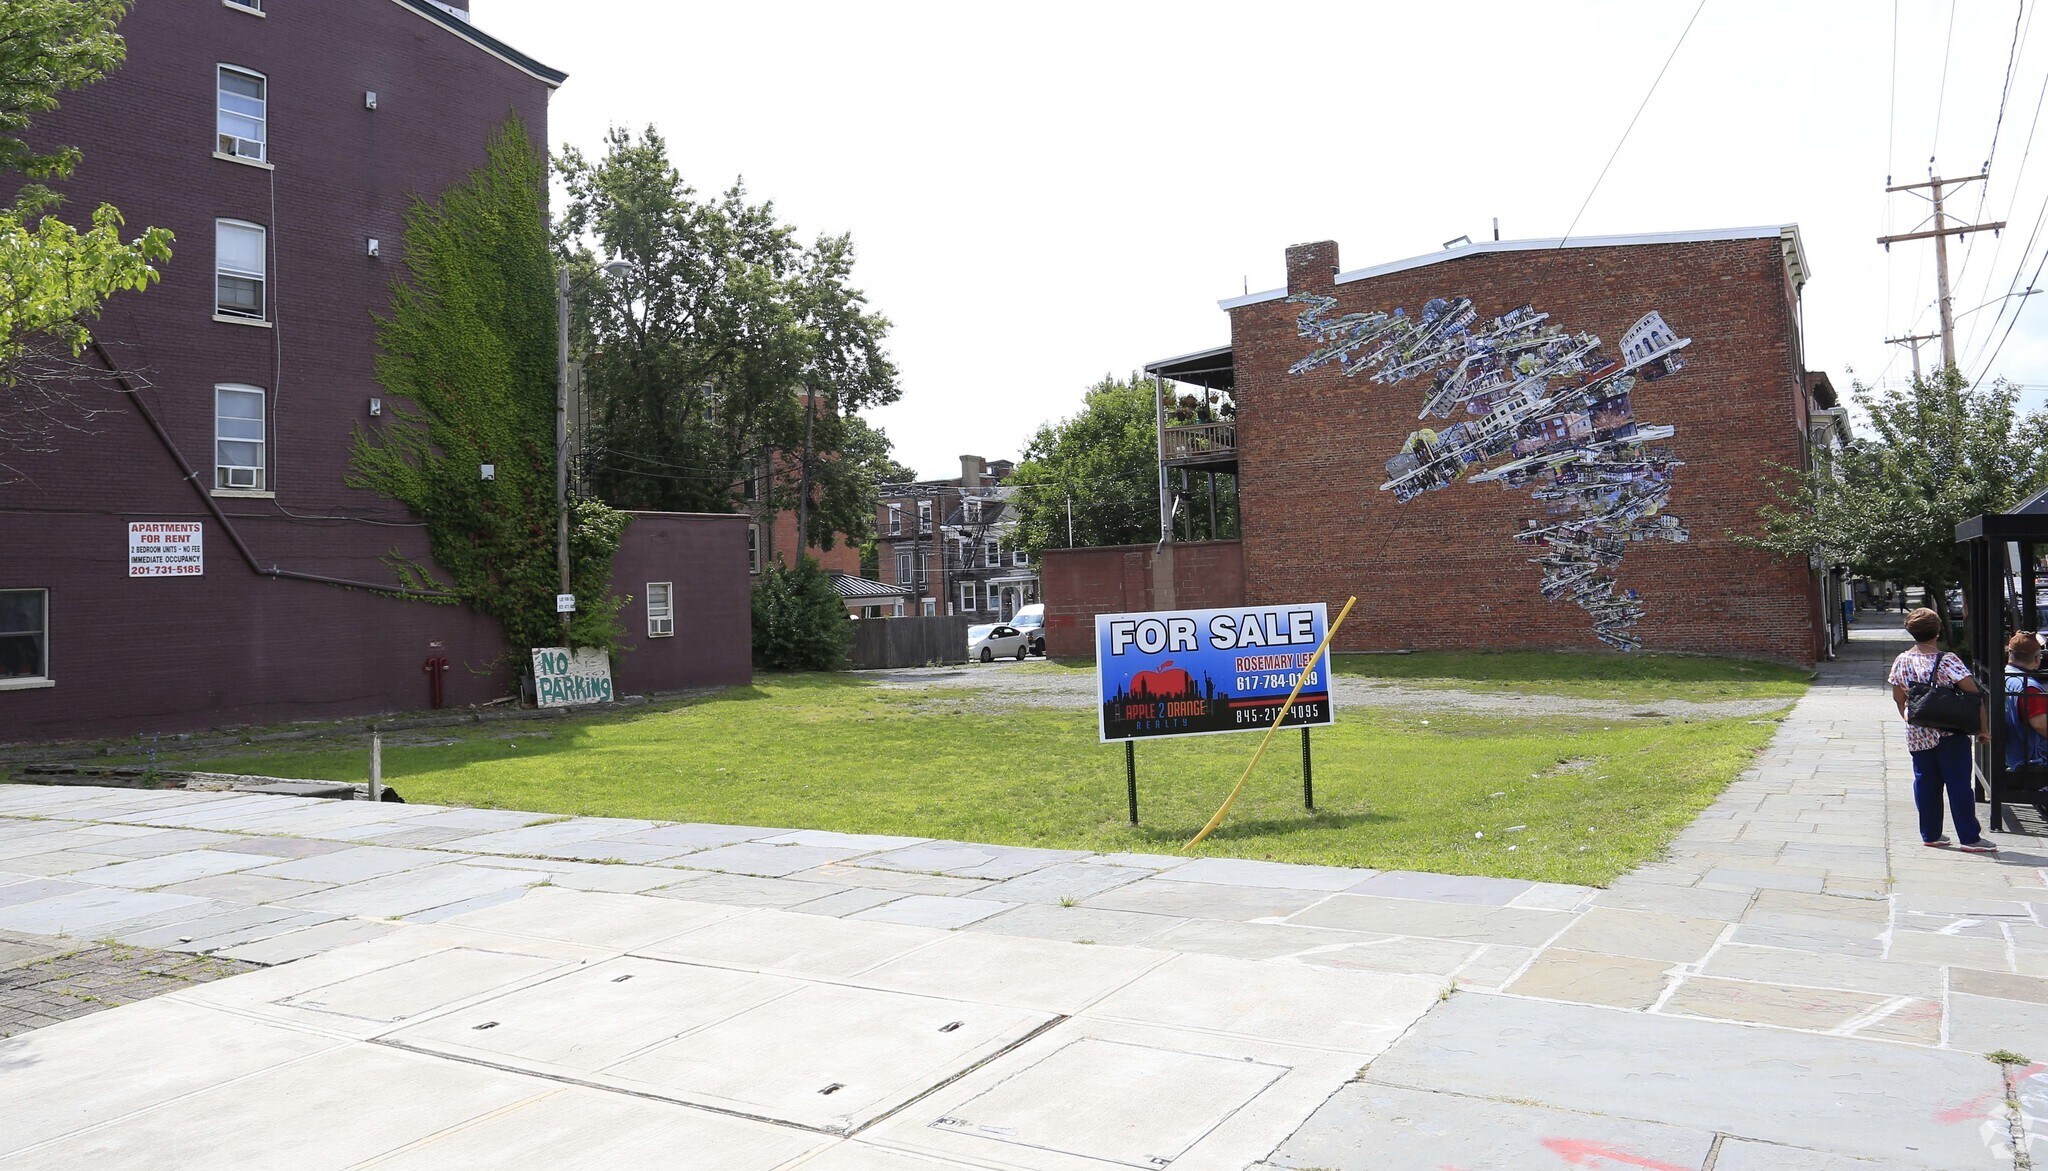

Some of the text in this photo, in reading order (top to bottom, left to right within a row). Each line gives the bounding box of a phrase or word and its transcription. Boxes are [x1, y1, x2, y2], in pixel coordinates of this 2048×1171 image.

[131, 524, 200, 532] APARTMENTS
[141, 535, 191, 543] FOR RENT
[131, 556, 163, 564] IMMEDIATE
[131, 565, 201, 575] 201-731-5185
[1110, 610, 1315, 656] FOR SALE
[541, 652, 568, 675] NO
[1236, 654, 1293, 672] ROSEMARY
[1126, 700, 1206, 720] APPLE 2 ORANGE
[1136, 718, 1188, 730] REALTY
